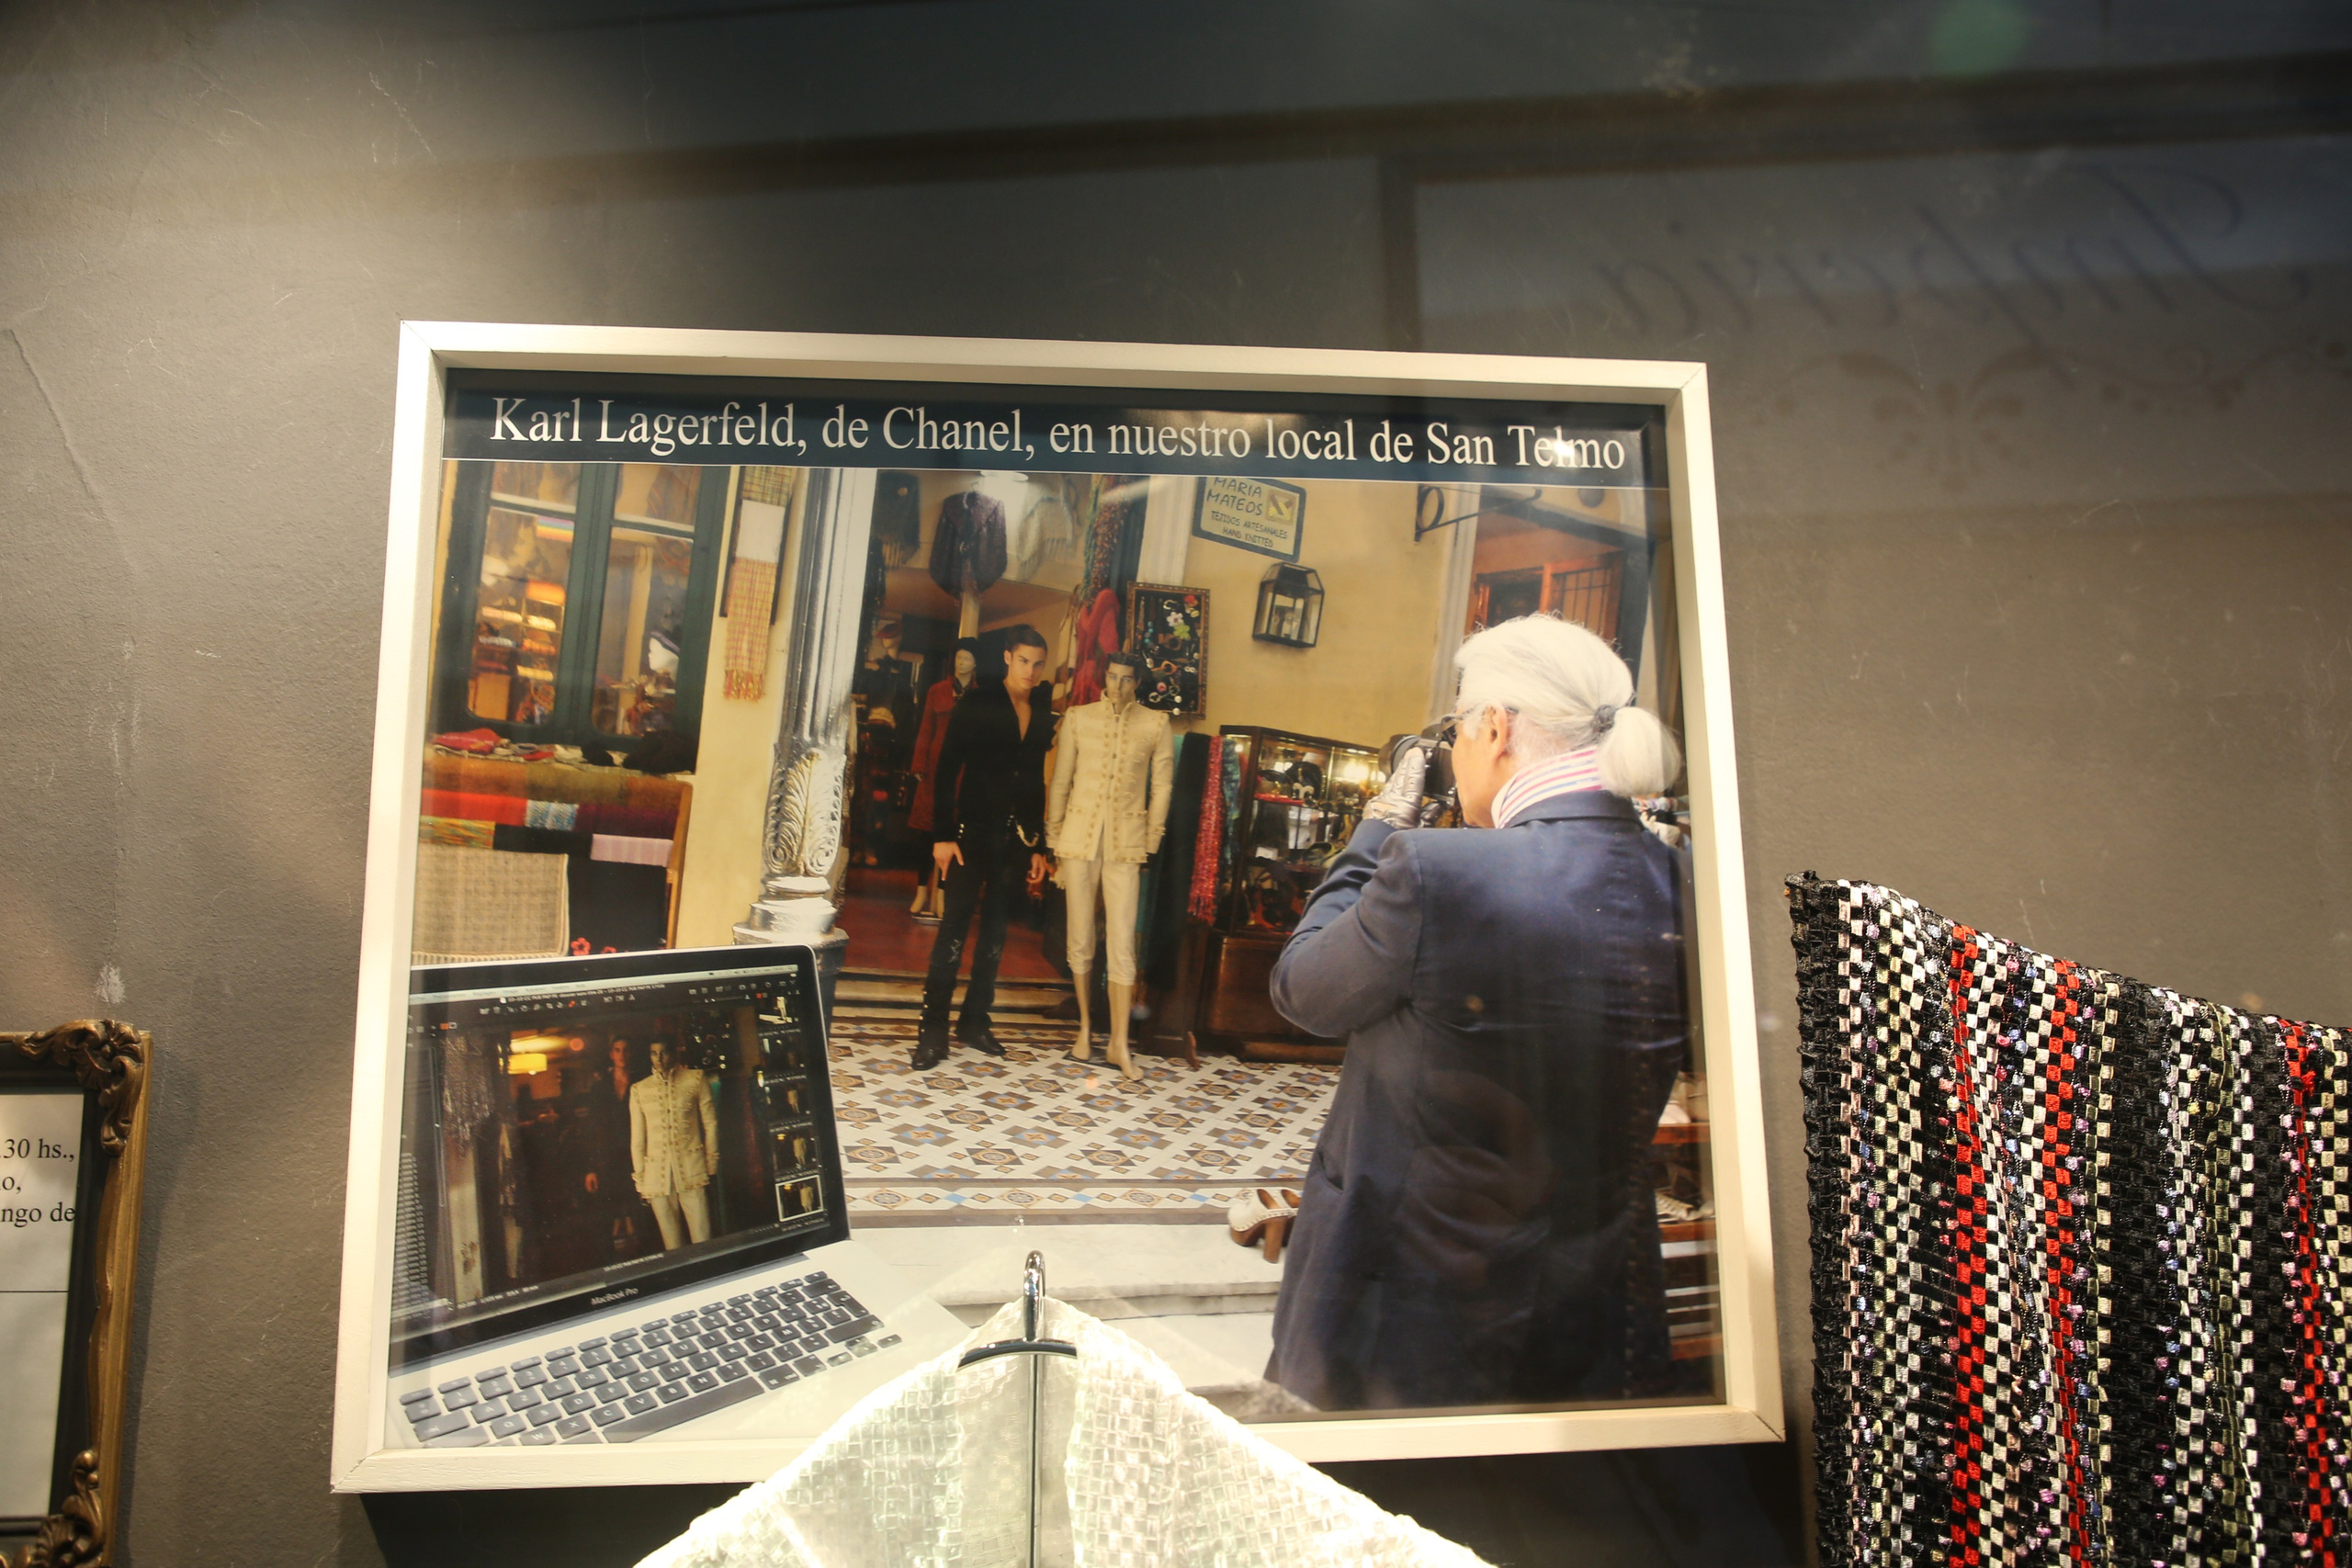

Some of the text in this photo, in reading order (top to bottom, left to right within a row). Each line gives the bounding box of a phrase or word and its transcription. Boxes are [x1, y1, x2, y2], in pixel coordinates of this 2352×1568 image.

[490, 397, 1625, 470] Karl Lagerfeld, de Chanel, en nuestro local de San Telmo
[1213, 477, 1262, 499] MARIA
[1205, 488, 1263, 516] MATEOS
[0, 1137, 75, 1163] 30 hs.,
[0, 1176, 22, 1195] o,
[50, 1201, 76, 1223] de
